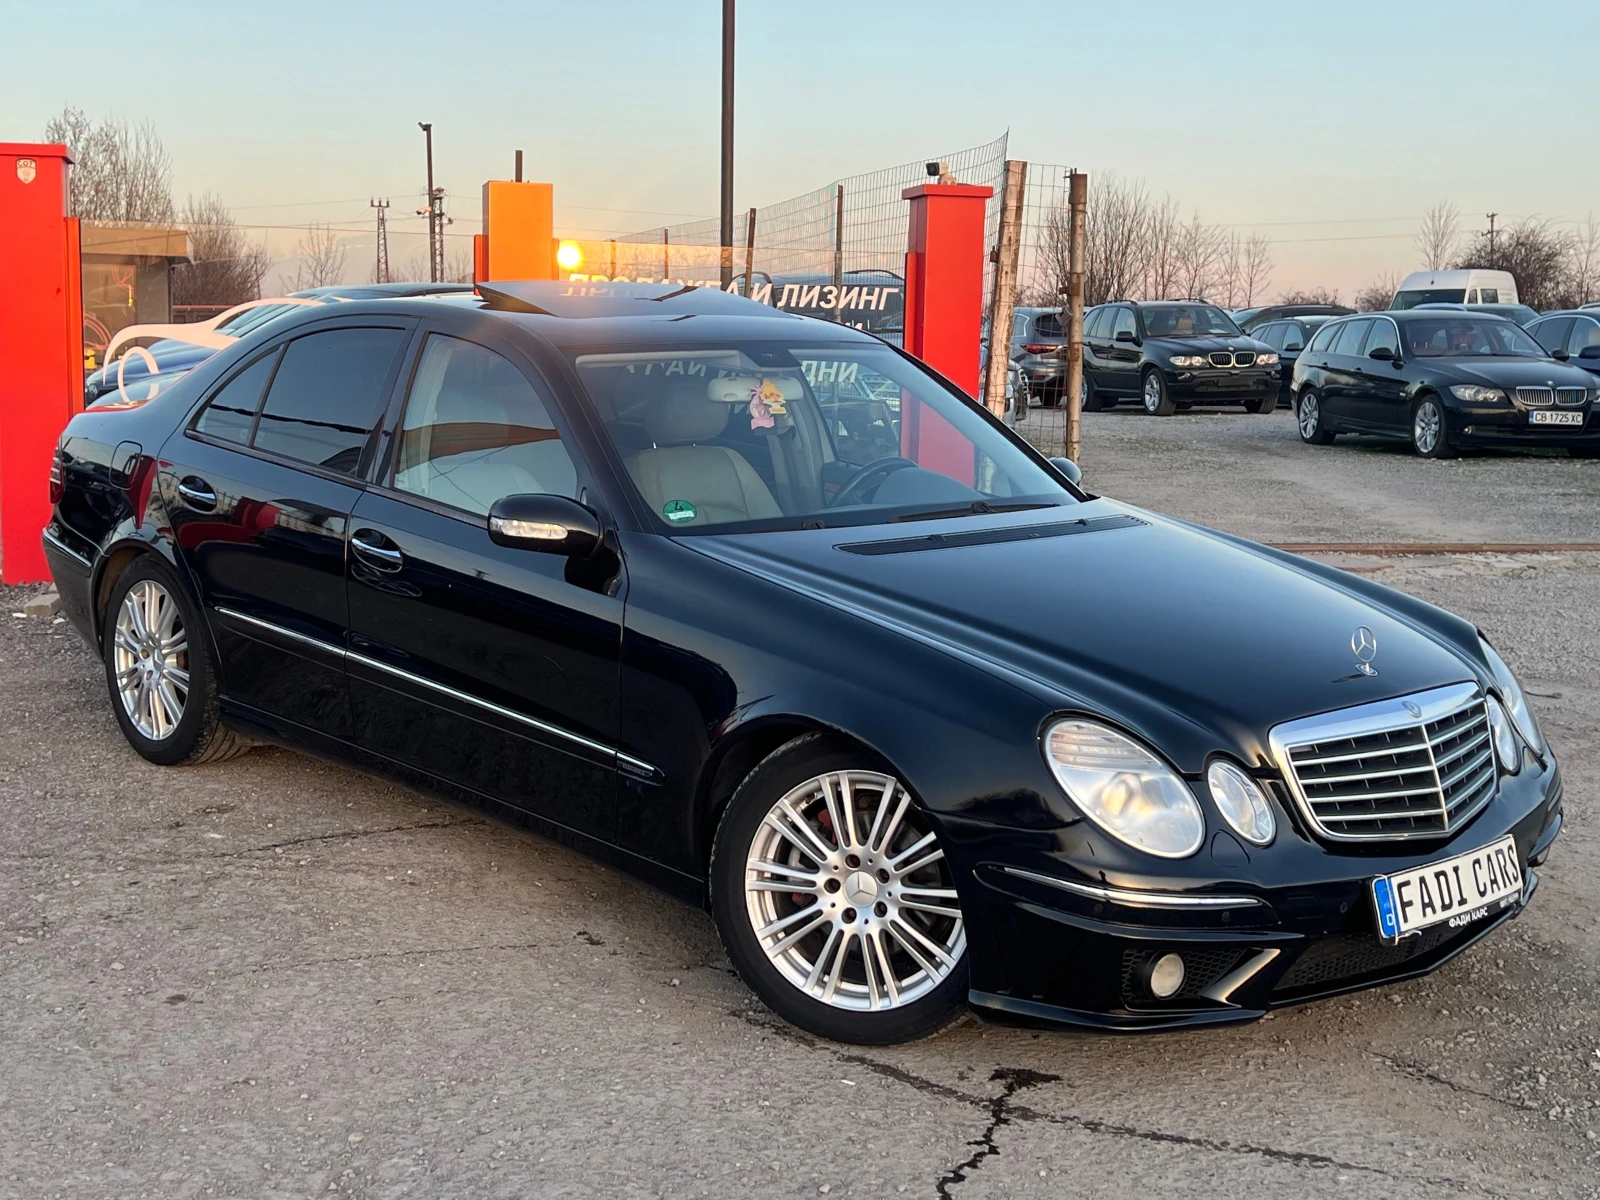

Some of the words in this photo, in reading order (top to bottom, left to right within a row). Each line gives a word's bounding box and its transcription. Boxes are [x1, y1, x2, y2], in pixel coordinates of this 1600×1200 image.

[751, 282, 773, 305] И
[777, 283, 899, 311] ЛИЗИНГ
[1535, 412, 1547, 422] CB
[1550, 413, 1569, 423] 1725
[1571, 414, 1582, 423] XC
[1396, 865, 1468, 924] FADI
[1472, 844, 1520, 898] CARS
[1448, 912, 1471, 928] ФАДИ
[1471, 906, 1489, 921] КАРС
